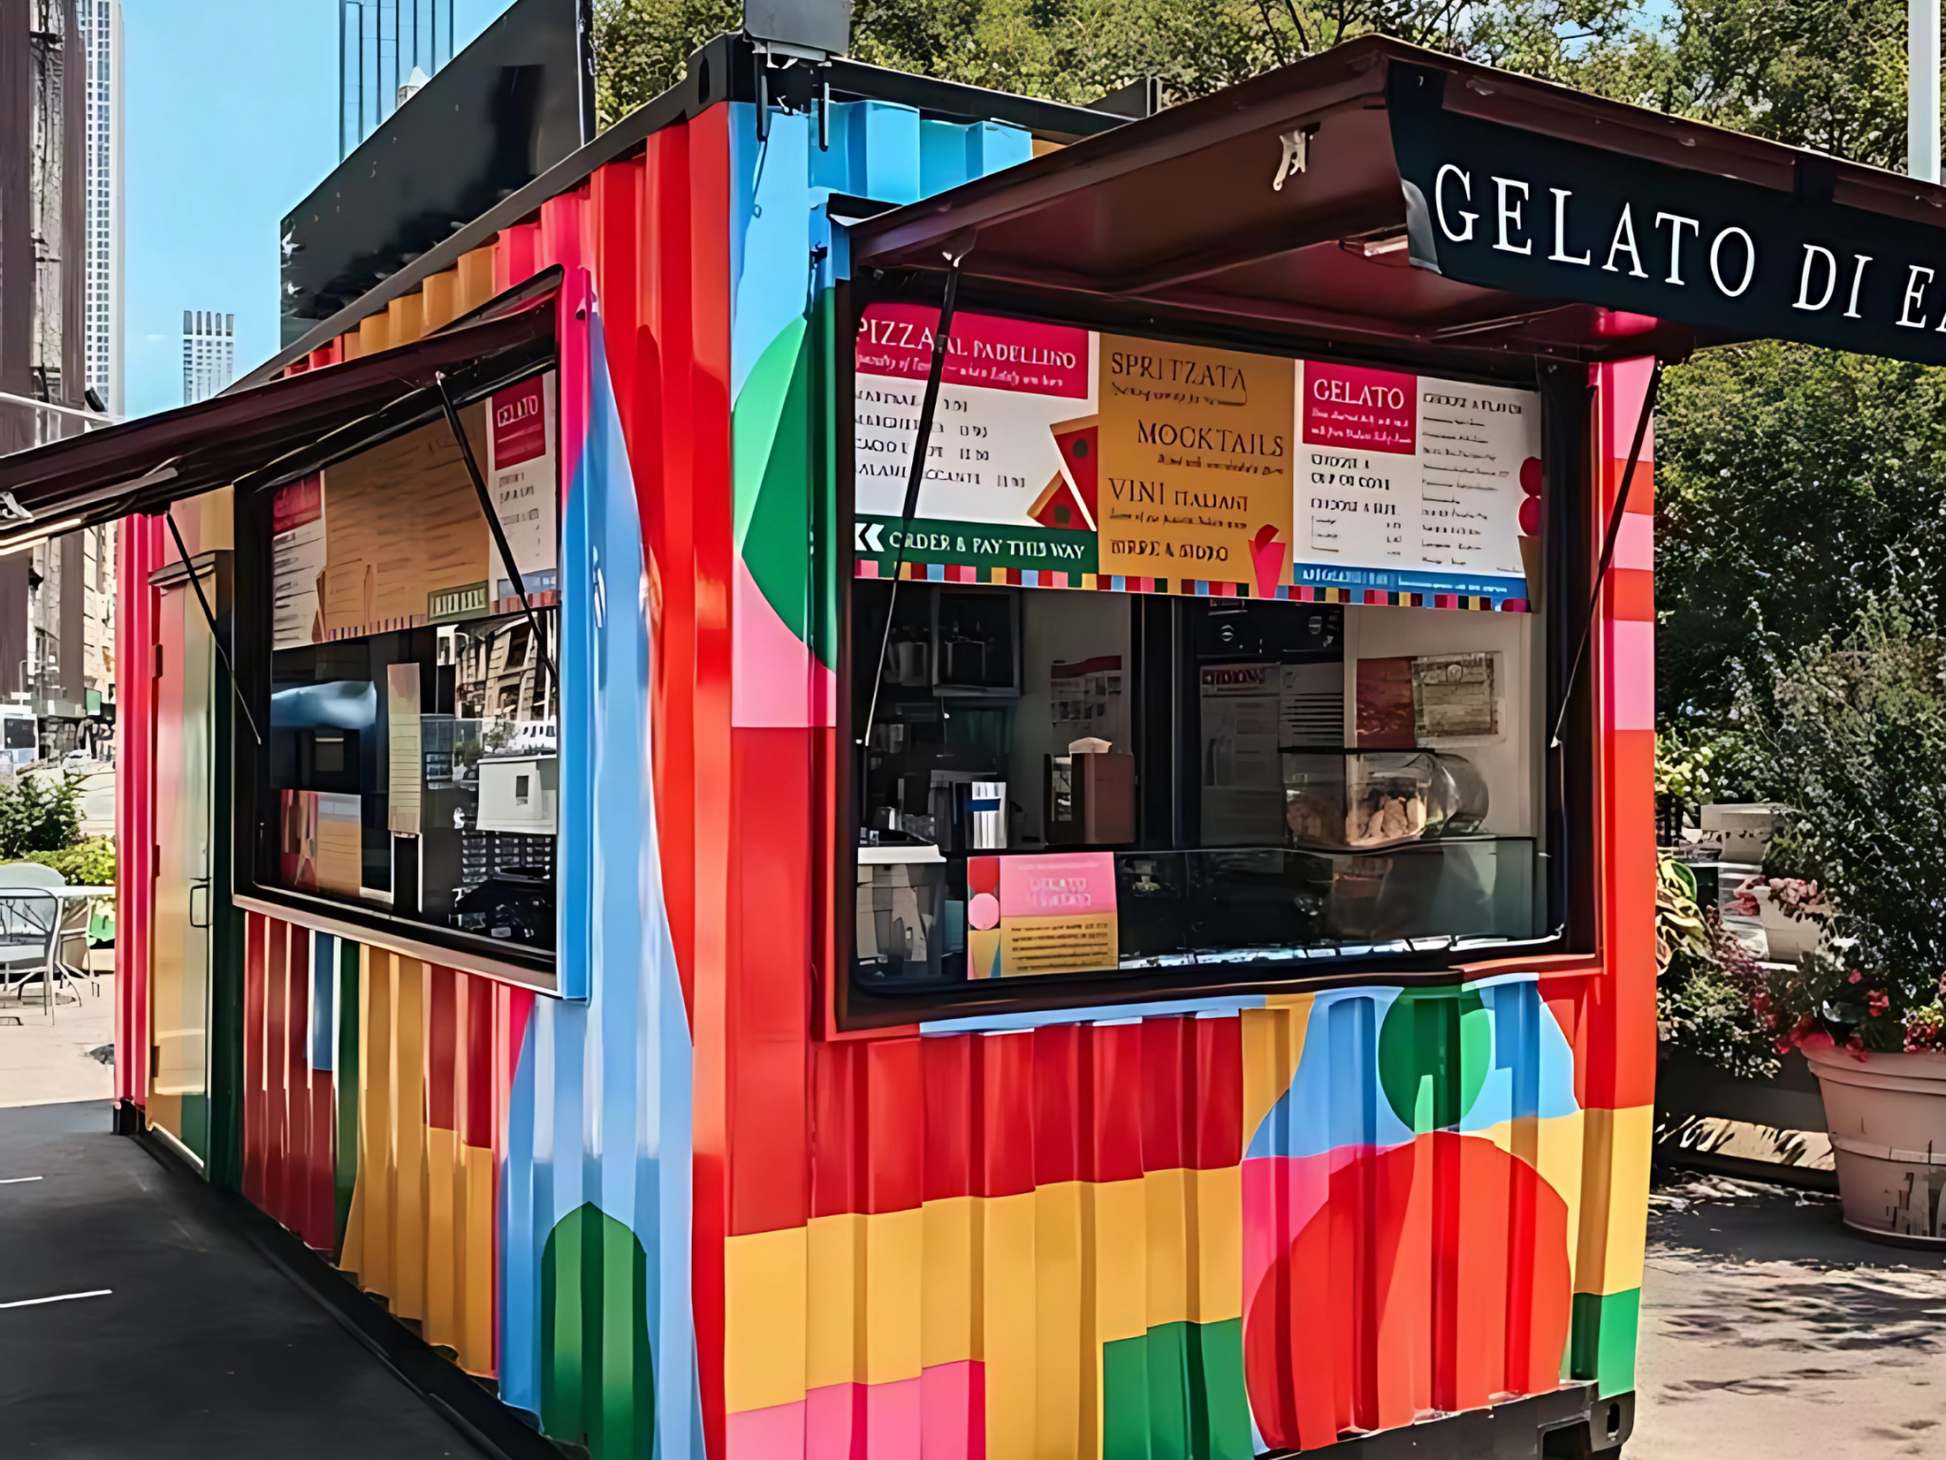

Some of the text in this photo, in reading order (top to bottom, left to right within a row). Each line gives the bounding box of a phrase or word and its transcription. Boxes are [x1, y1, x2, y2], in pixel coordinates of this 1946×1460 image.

[1434, 163, 1946, 333] GELATO DI E
[857, 317, 935, 352] PIZZA
[1111, 351, 1248, 392] SPRITZATA
[1313, 378, 1405, 410] GELATO
[1108, 477, 1165, 506] VINI
[888, 531, 950, 552] ORDER
[972, 537, 1004, 555] PAY
[1050, 542, 1086, 560] WAY
